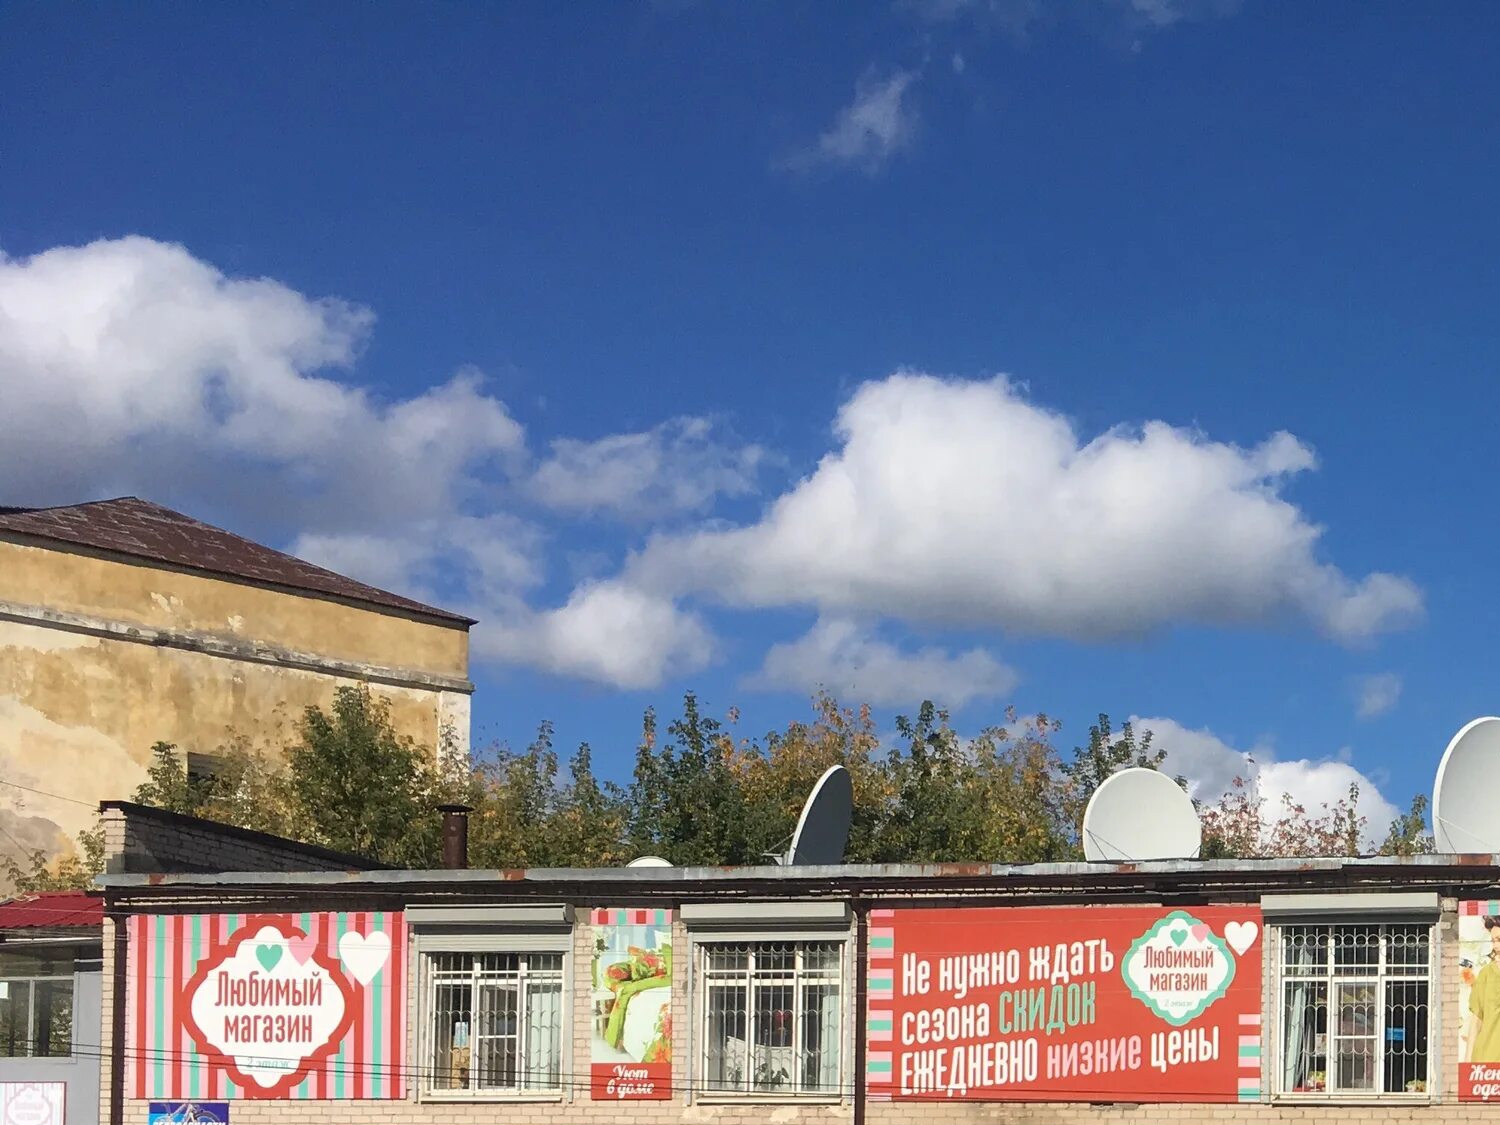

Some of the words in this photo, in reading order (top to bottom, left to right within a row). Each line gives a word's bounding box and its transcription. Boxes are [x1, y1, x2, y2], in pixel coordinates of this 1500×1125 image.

[902, 953, 930, 996] Не
[939, 949, 1020, 999] нужно
[1028, 938, 1114, 985] ждать
[1144, 946, 1214, 969] Любимый
[214, 971, 322, 1006] Любимый
[1150, 973, 1208, 991] магазин
[224, 1014, 313, 1043] магазин
[901, 1003, 990, 1045] сезона
[613, 1065, 649, 1081] Уют
[901, 1038, 1038, 1097] ЕЖЕДНЕВНО
[1047, 1035, 1142, 1079] низкие
[1150, 1025, 1220, 1074] цены
[606, 1079, 616, 1094] в
